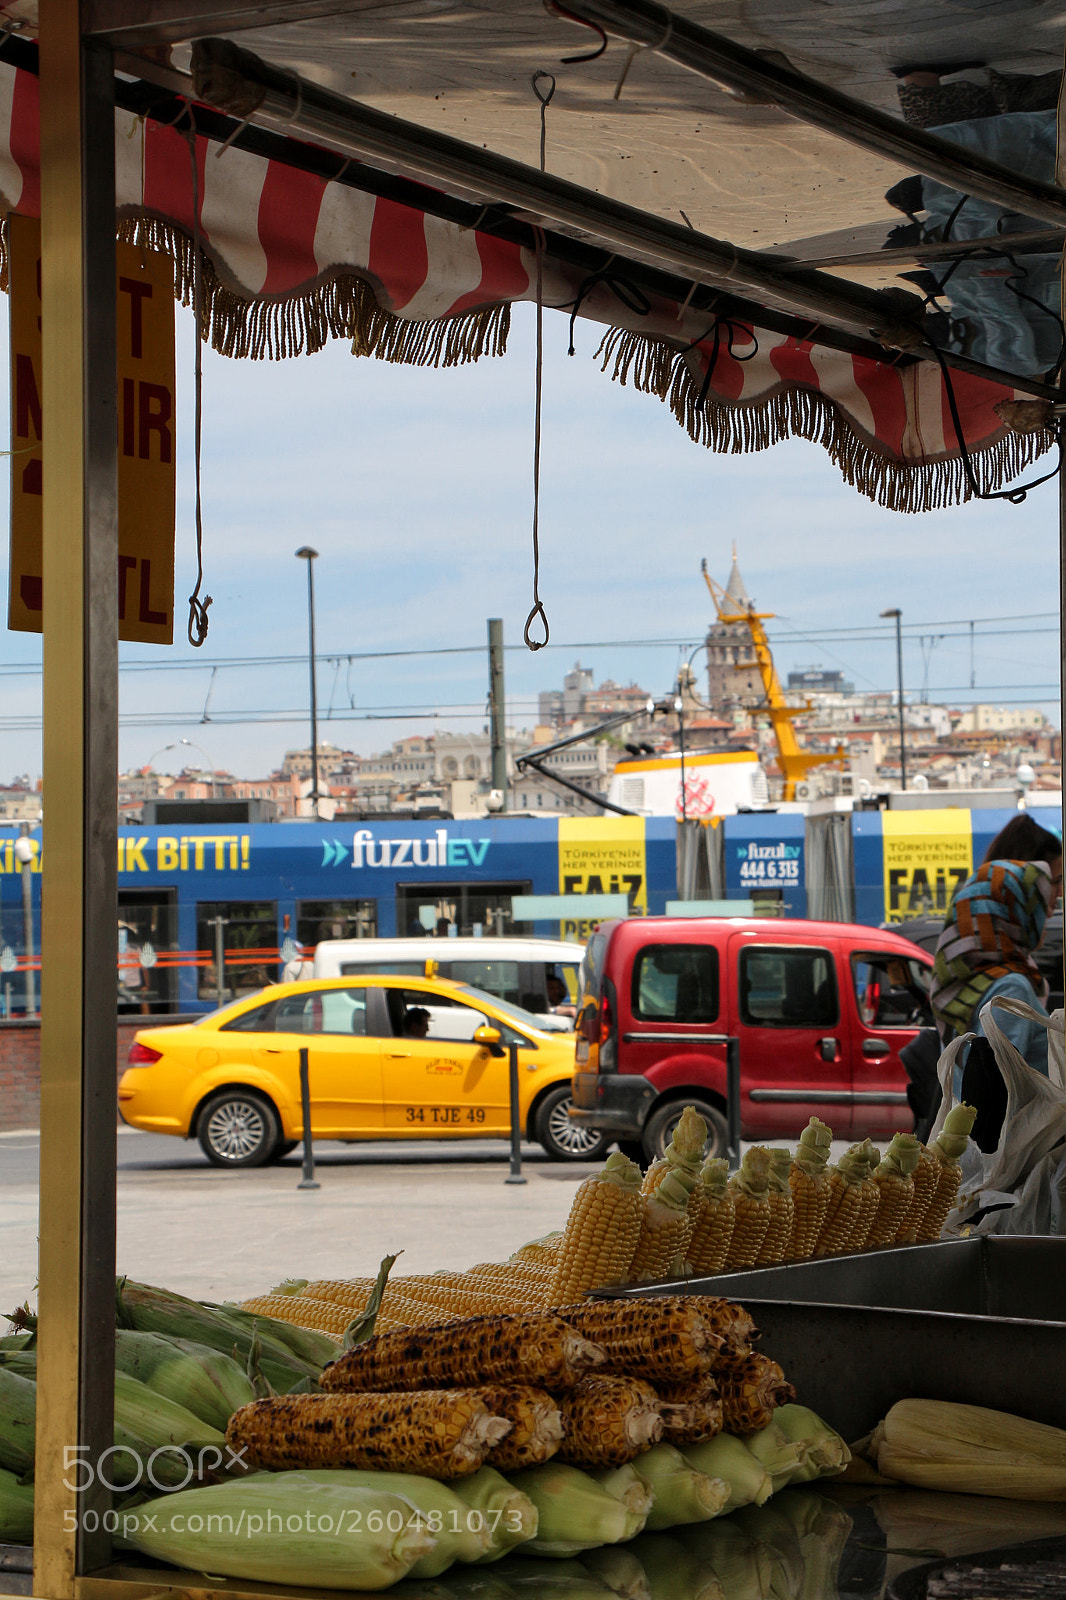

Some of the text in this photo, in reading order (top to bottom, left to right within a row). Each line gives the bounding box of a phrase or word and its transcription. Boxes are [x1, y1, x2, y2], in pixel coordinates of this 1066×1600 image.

[351, 829, 491, 868] fuzulEV
[562, 861, 587, 869] HER
[887, 854, 912, 862] HER
[740, 860, 799, 878] 444 6 313
[406, 1107, 485, 1123] 34 TJE 49
